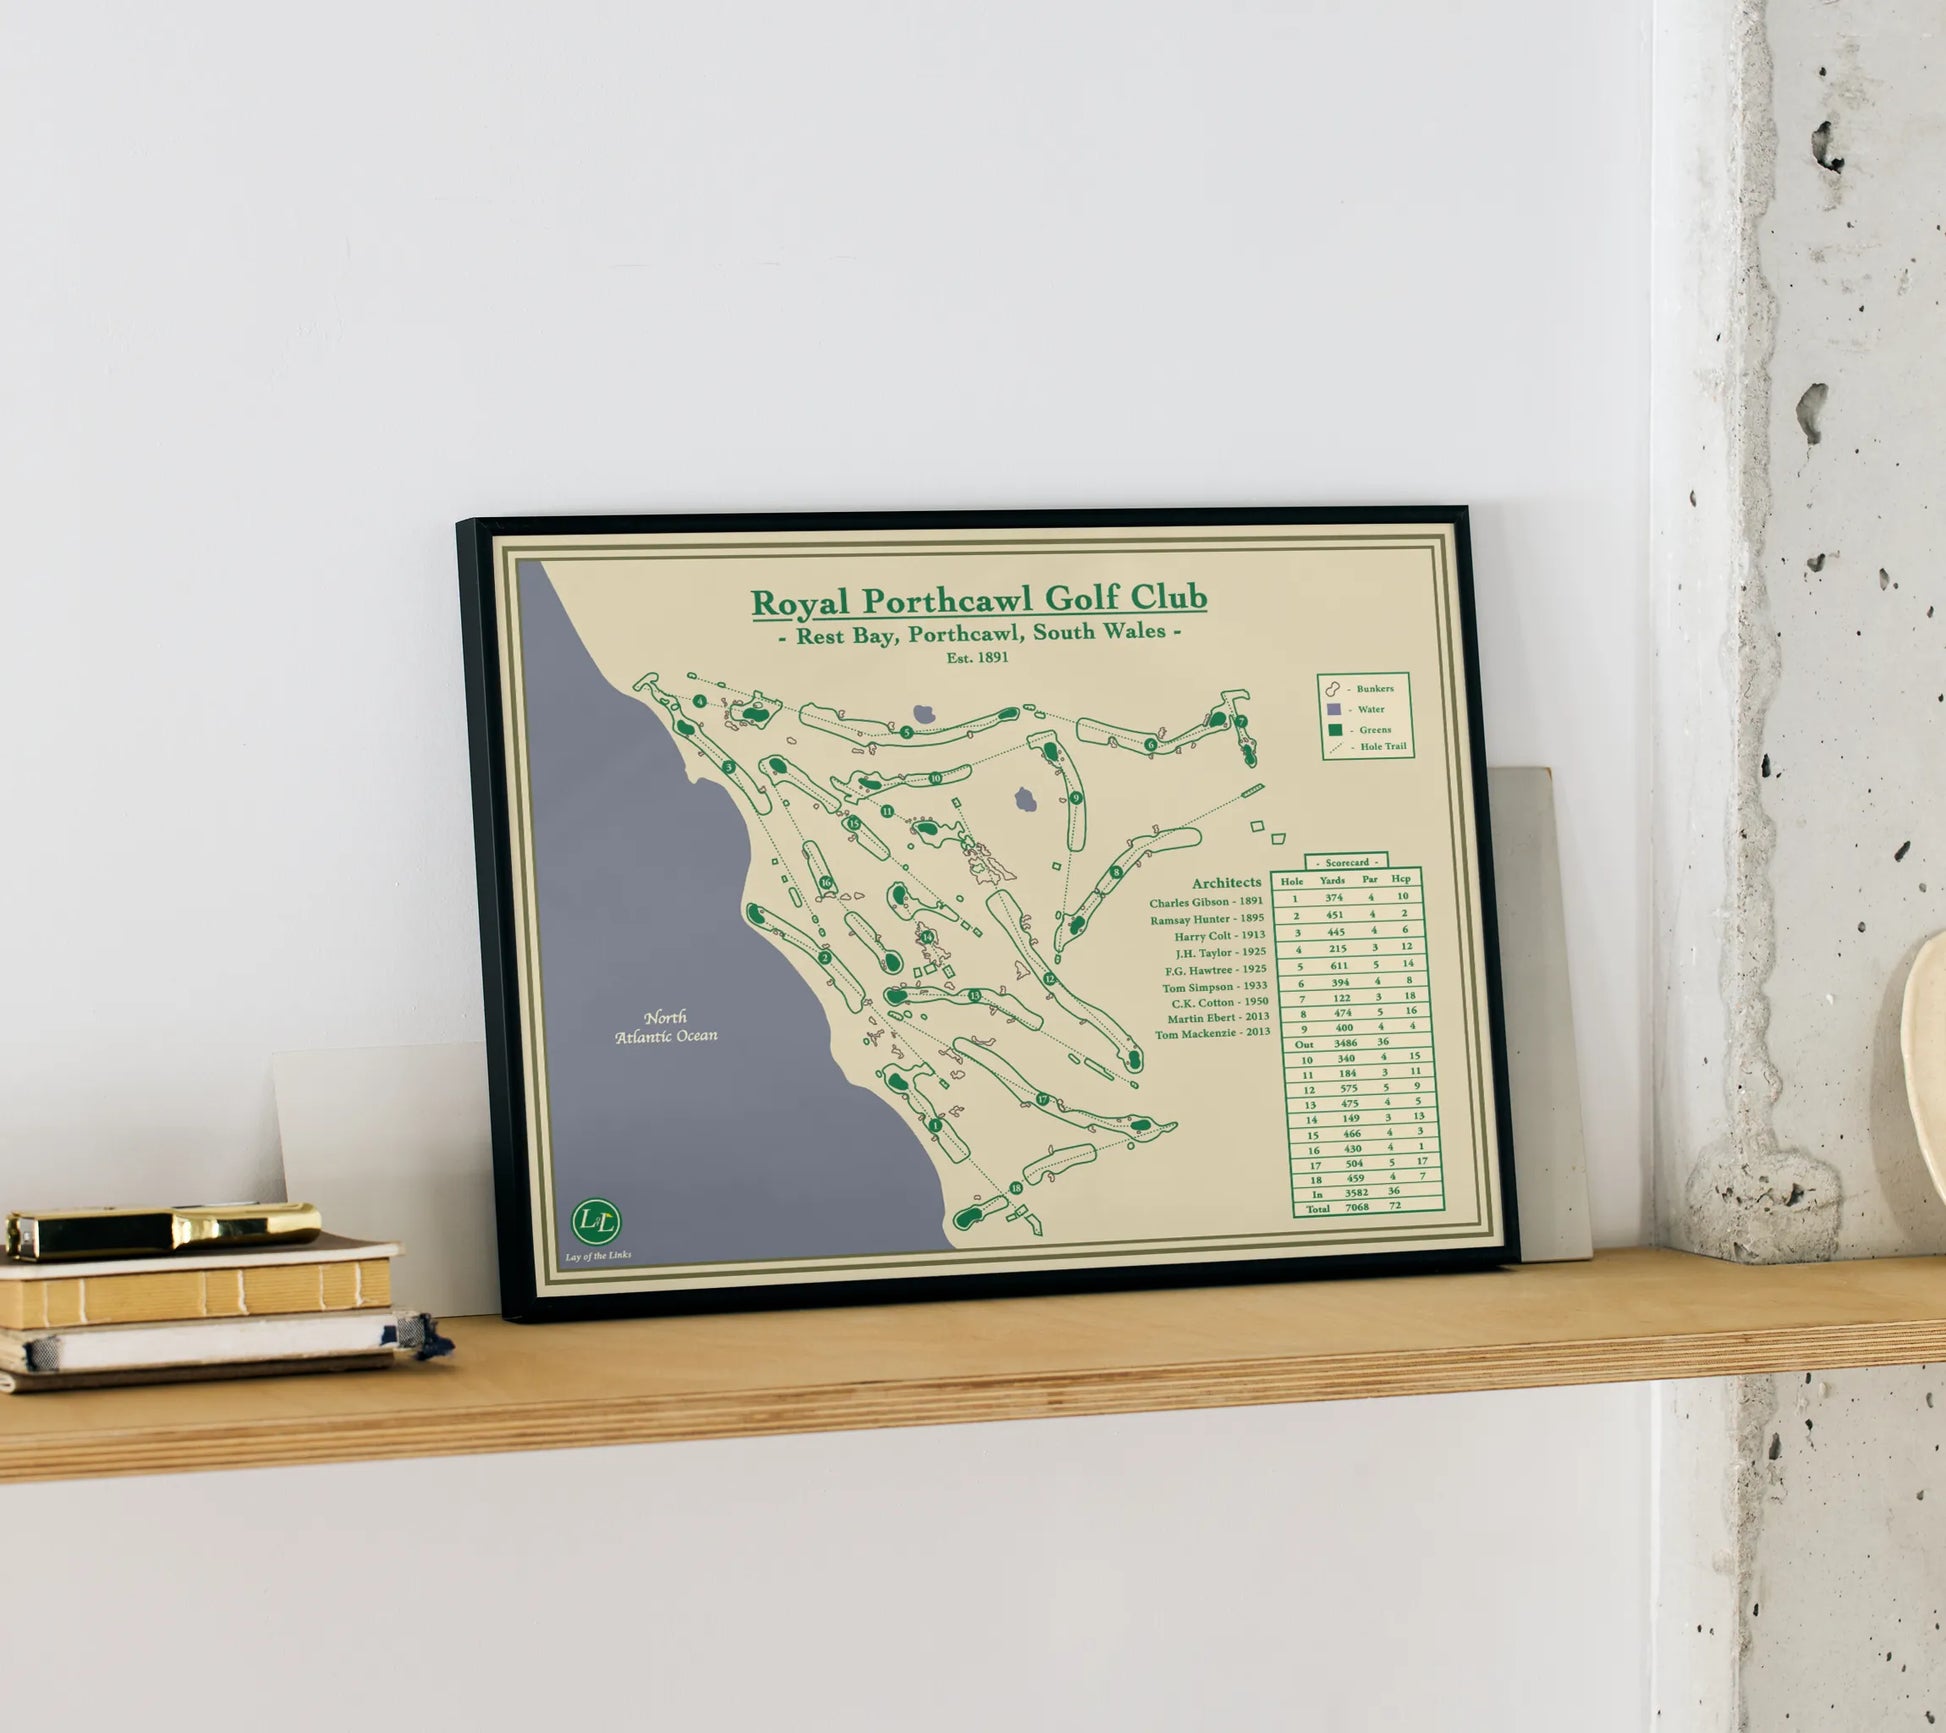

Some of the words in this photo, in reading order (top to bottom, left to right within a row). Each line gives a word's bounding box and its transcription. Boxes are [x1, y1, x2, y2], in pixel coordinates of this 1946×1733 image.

[751, 587, 850, 623] Royal
[862, 585, 1033, 614] Porthcawl
[1046, 583, 1121, 611] Golf
[1131, 582, 1208, 609] Club
[796, 628, 845, 644] Rest
[853, 627, 899, 648] Bay,
[908, 623, 1025, 643] Porthcawl,
[1034, 622, 1096, 640] South
[1103, 621, 1166, 639] Wales
[947, 652, 973, 664] Est.
[979, 651, 1008, 663] 1891
[1357, 685, 1394, 693] Bunkers
[698, 697, 703, 705] 4
[1360, 726, 1391, 734] Greens
[1385, 742, 1407, 750] Trail
[850, 819, 859, 827] 15
[1326, 858, 1369, 867] Scorecard
[1192, 877, 1262, 889] Architects
[1281, 877, 1303, 886] Hole
[1320, 876, 1345, 885] Yards
[1362, 875, 1378, 883] Par
[1391, 874, 1411, 885] Hcp
[1149, 898, 1189, 908] Charles
[1192, 898, 1229, 907] Gibson
[1240, 896, 1263, 905] 1891
[1293, 895, 1297, 903] 1
[1326, 893, 1343, 902] 374
[1368, 893, 1374, 901] 4
[1398, 892, 1409, 900] 10
[1151, 917, 1191, 926] Ramsay
[1194, 915, 1230, 924] Hunter
[1241, 913, 1264, 922] 1895
[1294, 912, 1300, 920] 2
[1327, 911, 1343, 919] 451
[1370, 910, 1375, 918] 4
[1402, 909, 1408, 917] 2
[1175, 933, 1206, 943] Harry
[1208, 931, 1231, 940] Colt
[1242, 930, 1266, 939] 1913
[1295, 929, 1301, 937] 3
[1328, 928, 1345, 936] 445
[1371, 926, 1377, 934] 4
[1402, 925, 1408, 933] 6
[1176, 949, 1196, 960] J.H.
[1199, 948, 1232, 959] Taylor
[1243, 947, 1266, 956] 1925
[1296, 946, 1302, 954] 4
[1329, 945, 1347, 953] 215
[1402, 942, 1413, 950] 12
[1165, 967, 1186, 976] F.G.
[1189, 967, 1232, 975] Hawtree
[1243, 964, 1267, 973] 1925
[1297, 963, 1303, 971] 5
[1330, 962, 1348, 970] 611
[1373, 961, 1379, 969] 5
[1403, 959, 1414, 967] 14
[1046, 975, 1054, 983] 12
[1298, 980, 1304, 988] 6
[1332, 978, 1349, 987] 394
[1375, 977, 1381, 985] 4
[1407, 976, 1413, 984] 8
[1162, 985, 1186, 993] Tom
[1189, 983, 1233, 994] Simpson
[1244, 981, 1268, 990] 1933
[1172, 999, 1196, 1009] C.K.
[1198, 999, 1234, 1007] Cotton
[1245, 997, 1269, 1006] 1950
[1299, 995, 1306, 1003] 7
[1334, 994, 1351, 1002] 122
[1376, 993, 1382, 1001] 3
[1405, 992, 1416, 1000] 18
[644, 1008, 687, 1025] North
[1168, 1015, 1204, 1024] Martin
[1207, 1013, 1235, 1022] Ebert
[1246, 1012, 1270, 1021] 2013
[1301, 1010, 1307, 1018] 8
[1334, 1009, 1352, 1017] 474
[1377, 1008, 1383, 1016] 5
[1407, 1006, 1417, 1014] 16
[1155, 1031, 1178, 1040] Tom
[1182, 1029, 1236, 1039] Mackenzie
[1247, 1027, 1271, 1036] 2013
[1301, 1025, 1308, 1034] 9
[1336, 1024, 1353, 1032] 400
[1378, 1022, 1384, 1030] 4
[615, 1029, 672, 1044] Atlantic
[677, 1029, 718, 1042] Ocean
[1295, 1041, 1314, 1049] Out
[1334, 1039, 1357, 1048] 3486
[1377, 1037, 1389, 1046] 36
[1302, 1056, 1313, 1064] 10
[1338, 1054, 1355, 1063] 340
[1410, 1052, 1421, 1060] 15
[1340, 1069, 1356, 1077] 184
[1382, 1068, 1388, 1077] 3
[1411, 1067, 1421, 1075] 11
[1304, 1086, 1315, 1094] 12
[1340, 1084, 1358, 1093] 575
[1384, 1083, 1389, 1092] 5
[1414, 1082, 1420, 1090] 9
[1306, 1101, 1316, 1109] 13
[1341, 1099, 1359, 1108] 475
[1385, 1097, 1390, 1105] 4
[1416, 1097, 1421, 1105] 5
[1307, 1116, 1318, 1124] 14
[1343, 1114, 1360, 1122] 149
[1386, 1113, 1391, 1122] 3
[1414, 1112, 1425, 1120] 13
[1308, 1131, 1319, 1140] 15
[1344, 1129, 1361, 1138] 466
[1387, 1128, 1393, 1136] 4
[1418, 1127, 1423, 1135] 3
[1309, 1146, 1320, 1155] 16
[1344, 1145, 1362, 1153] 430
[1388, 1143, 1393, 1151] 4
[1311, 1162, 1321, 1170] 17
[1346, 1159, 1363, 1168] 504
[1390, 1158, 1395, 1167] 5
[1418, 1157, 1428, 1165] 17
[1311, 1176, 1322, 1184] 18
[1347, 1174, 1365, 1183] 459
[1390, 1172, 1396, 1180] 4
[1420, 1172, 1426, 1180] 7
[1313, 1191, 1323, 1199] In
[1345, 1189, 1368, 1197] 3582
[1389, 1186, 1400, 1195] 36
[1306, 1204, 1330, 1213] Total
[1346, 1203, 1369, 1211] 7068
[1389, 1201, 1401, 1210] 72
[565, 1253, 582, 1263] Lay
[583, 1252, 593, 1262] of
[594, 1252, 607, 1260] the
[609, 1250, 632, 1259] Links
